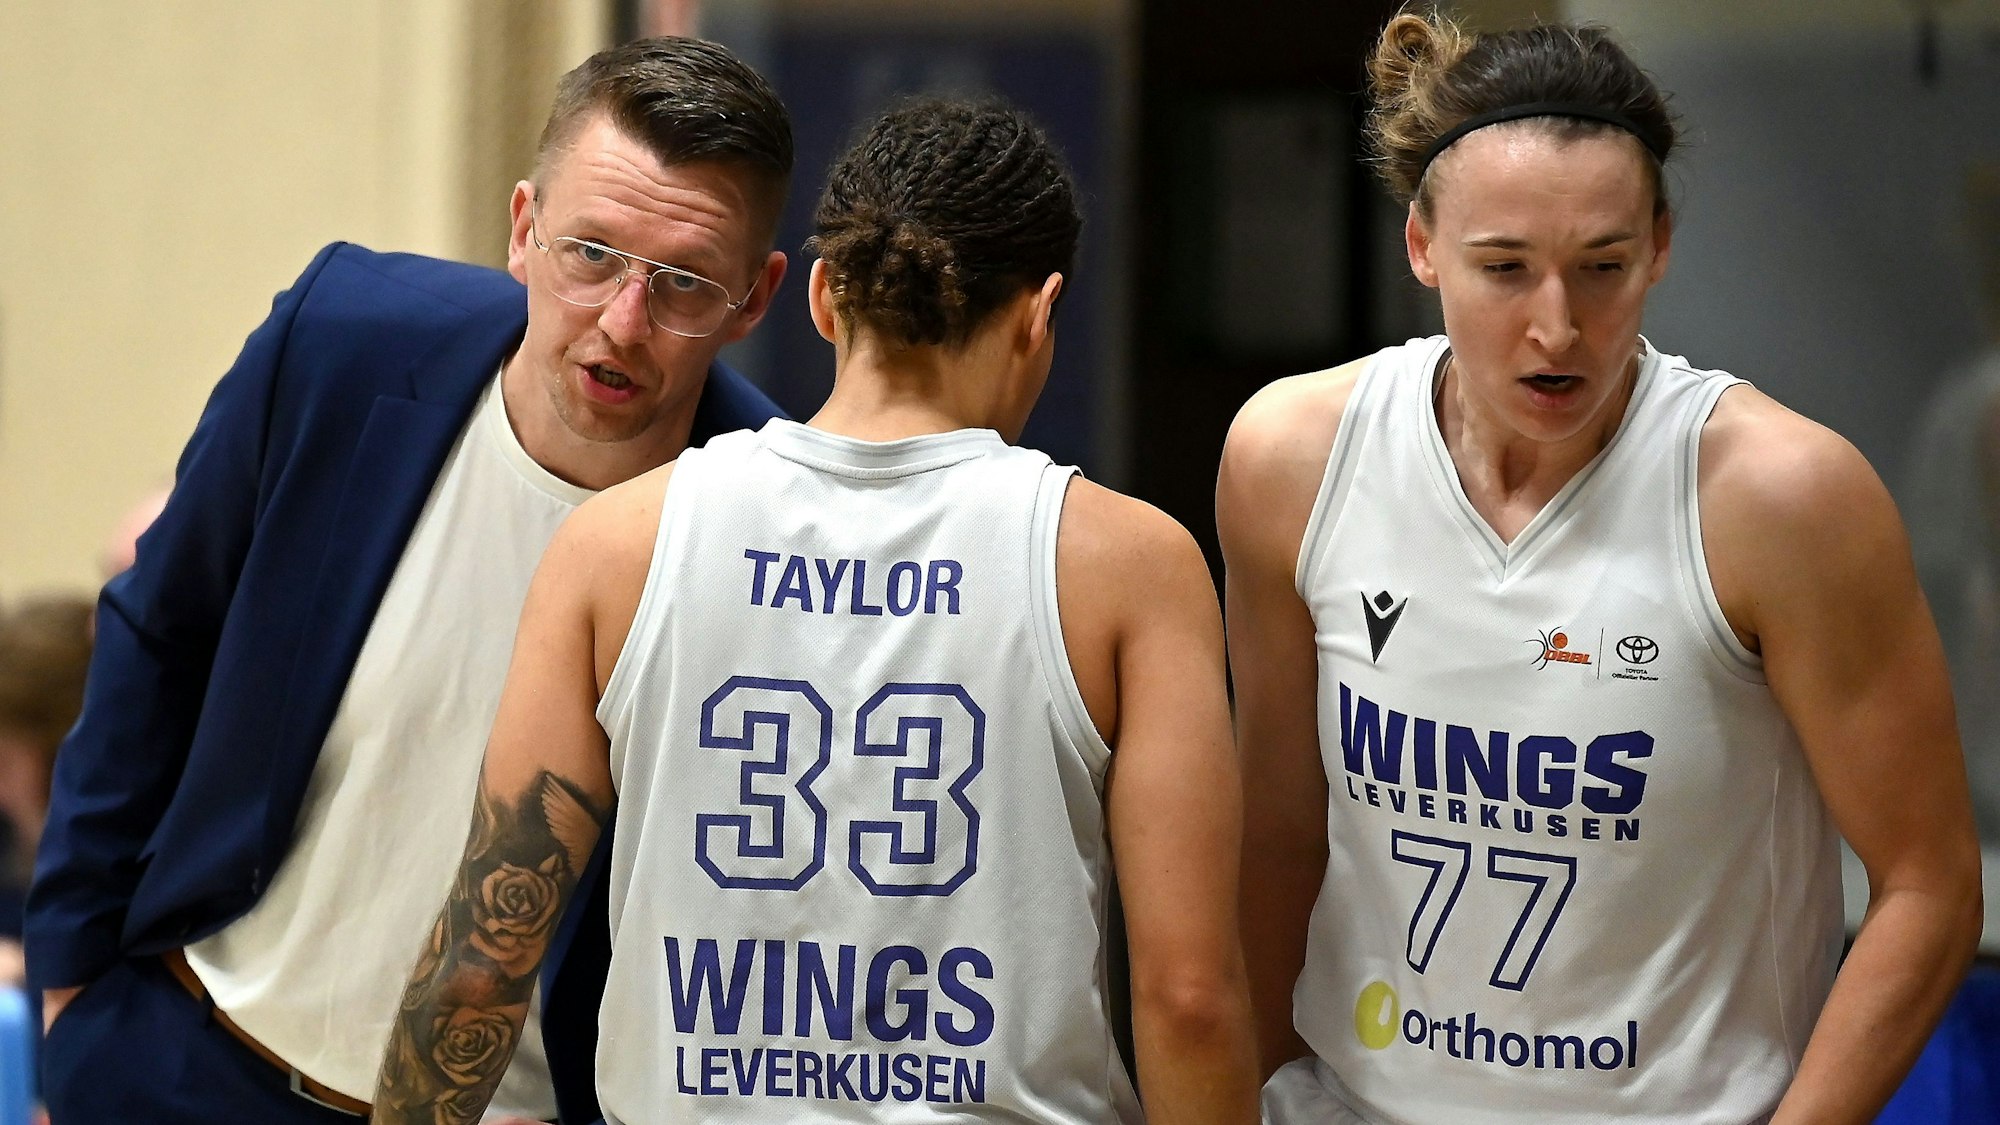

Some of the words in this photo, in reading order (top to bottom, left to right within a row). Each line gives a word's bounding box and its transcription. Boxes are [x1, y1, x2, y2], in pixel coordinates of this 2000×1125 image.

[744, 548, 963, 616] TAYLOR
[695, 675, 986, 897] 33
[1339, 681, 1655, 814] WINGS
[1346, 776, 1640, 841] LEVERKUSEN
[1391, 829, 1577, 991] 77
[664, 936, 995, 1046] WINGS
[676, 1046, 986, 1104] LEVERKUSEN
